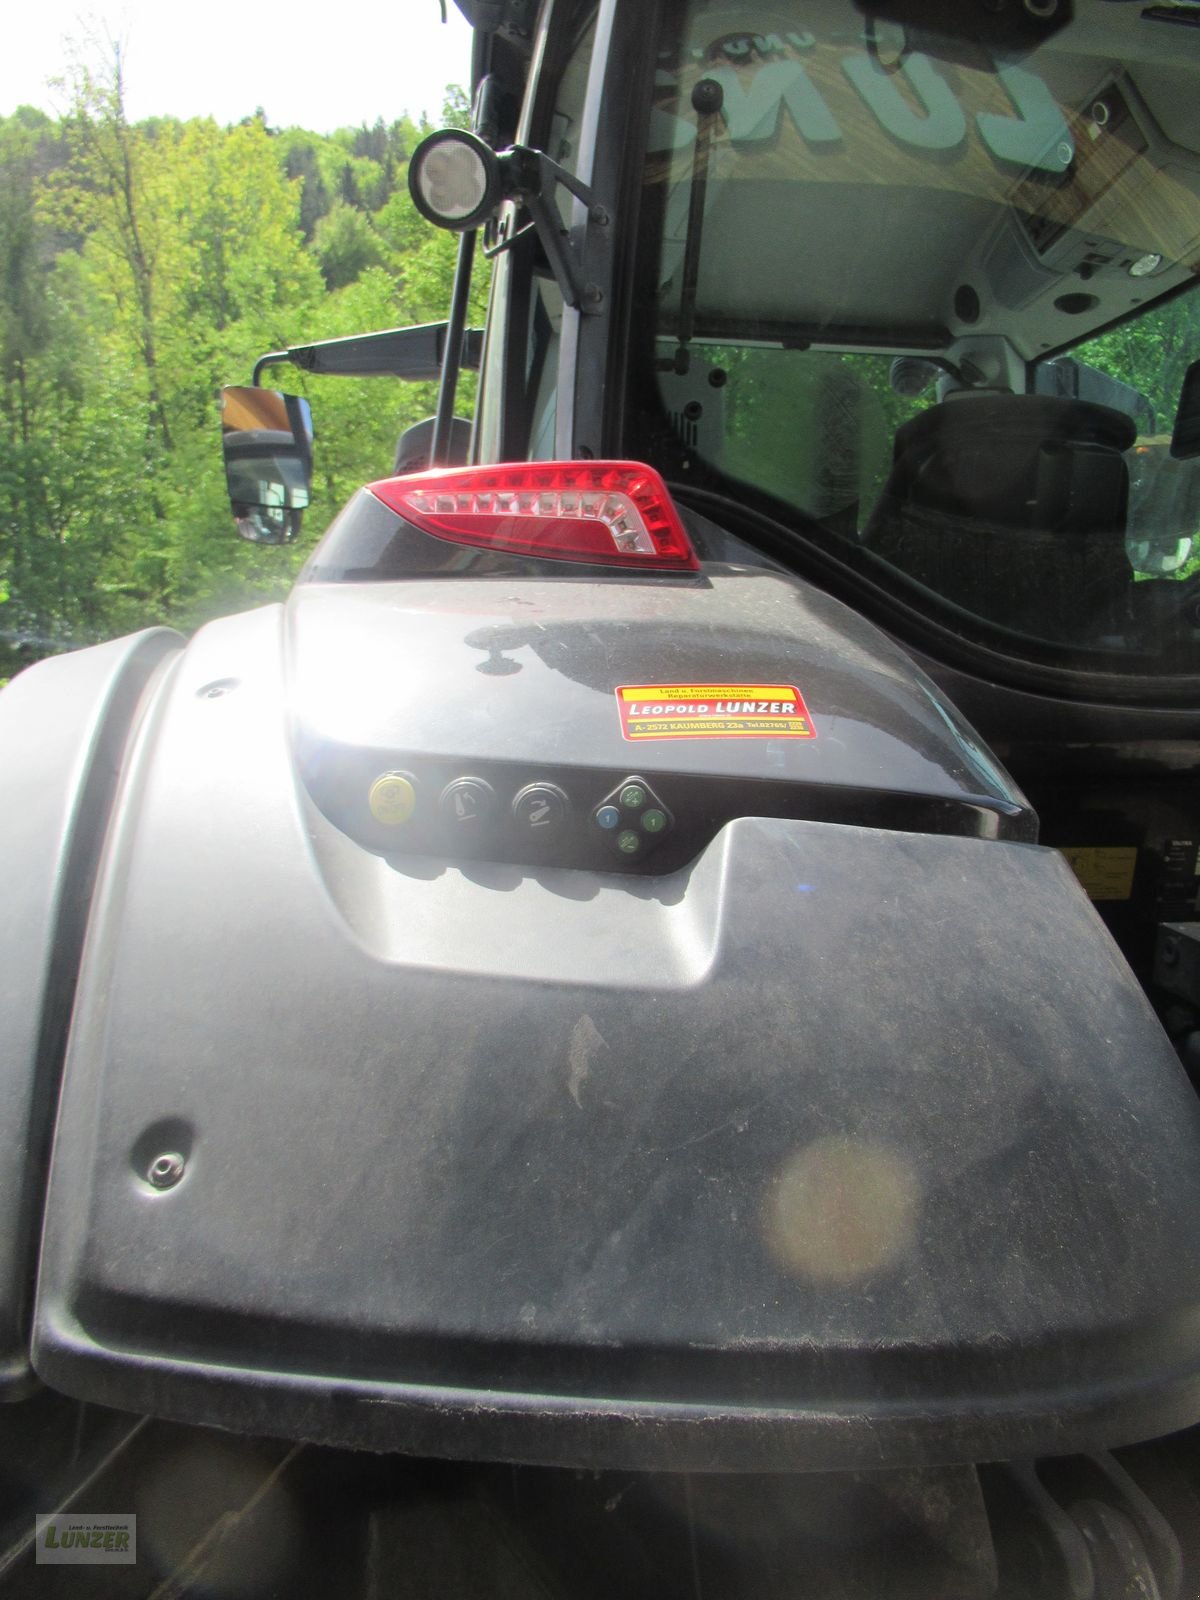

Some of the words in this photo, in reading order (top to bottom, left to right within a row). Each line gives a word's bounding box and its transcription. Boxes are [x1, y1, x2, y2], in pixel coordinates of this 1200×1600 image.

[630, 704, 709, 715] LEOPOLD
[716, 702, 796, 714] LUNZER
[647, 723, 668, 731] 2572
[670, 722, 725, 730] KAUMBERG
